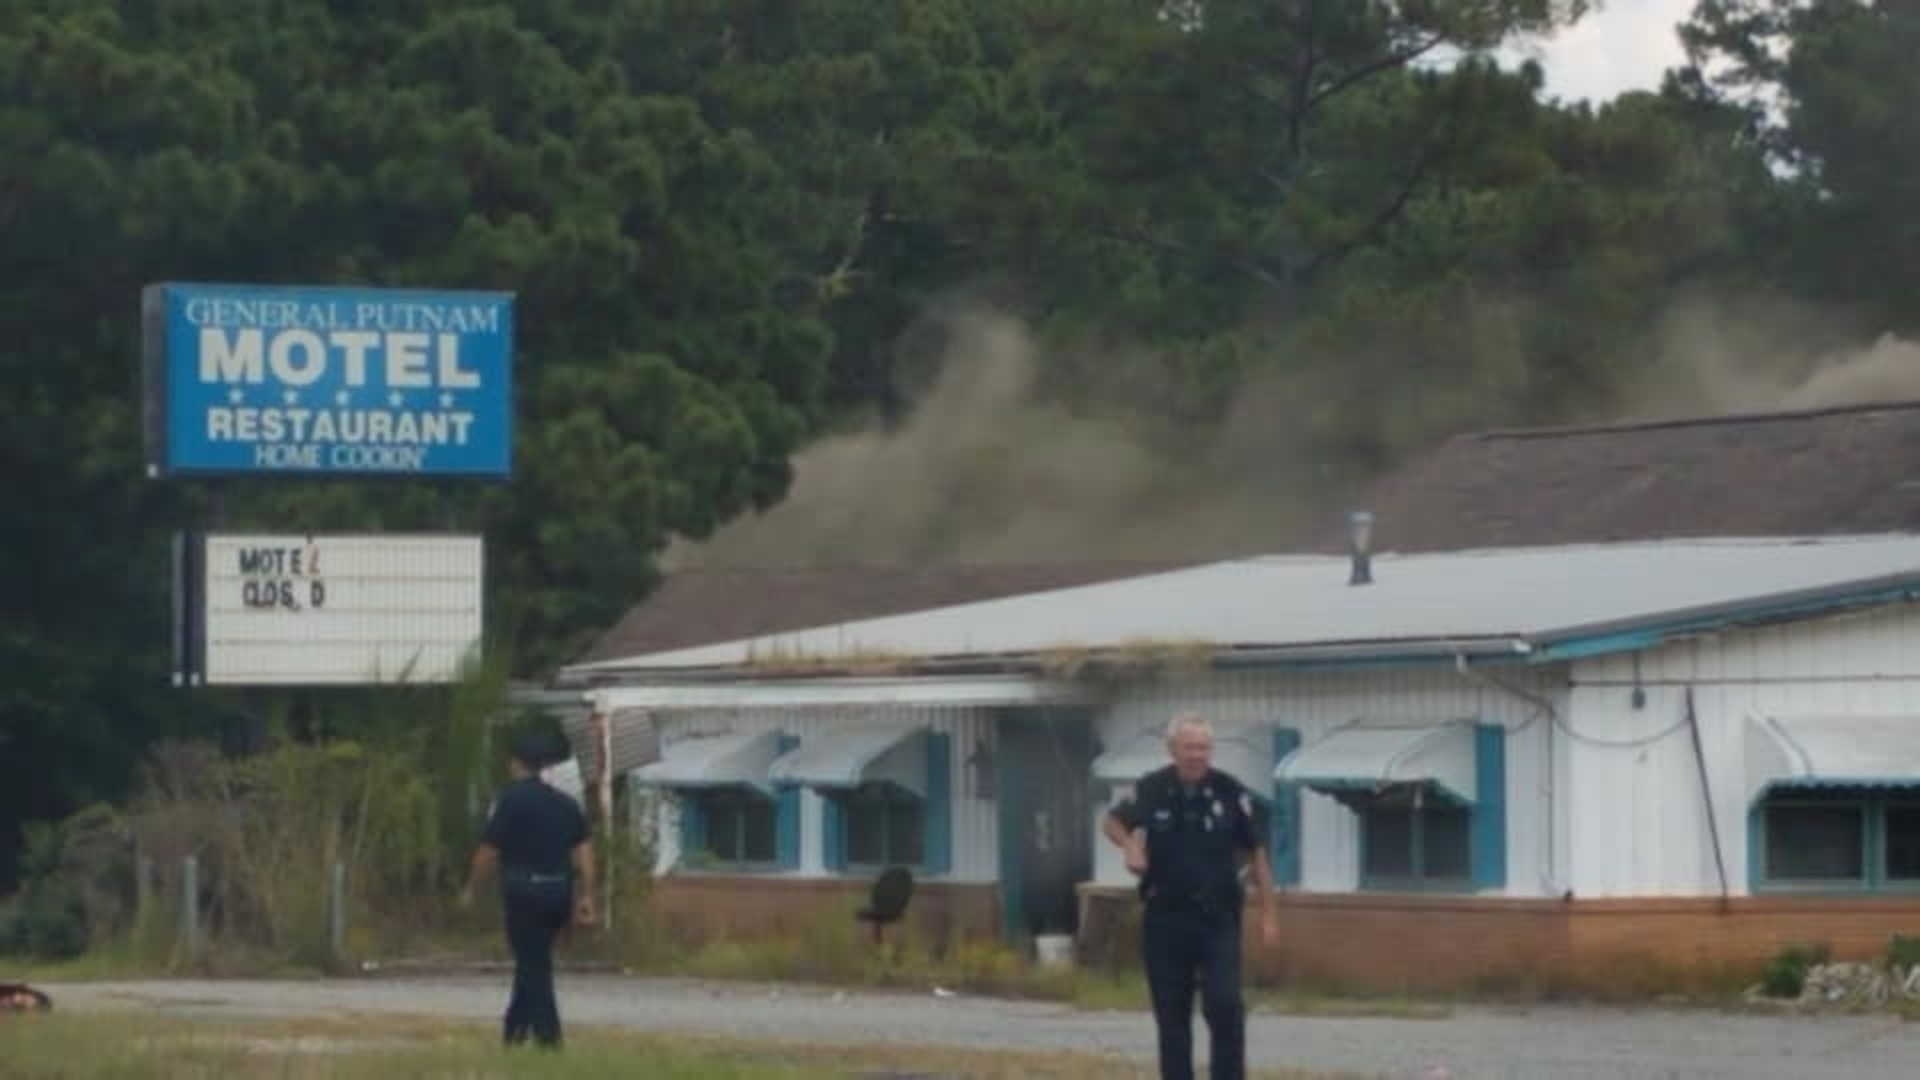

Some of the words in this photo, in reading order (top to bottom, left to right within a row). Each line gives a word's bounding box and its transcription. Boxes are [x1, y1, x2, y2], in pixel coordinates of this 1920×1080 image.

[186, 299, 347, 328] GENERAL
[357, 302, 499, 333] PUTNAM
[199, 328, 480, 388] MOTEL
[207, 408, 473, 445] RESTAURANT
[255, 445, 320, 469] HOME
[239, 545, 320, 575] MOTEL
